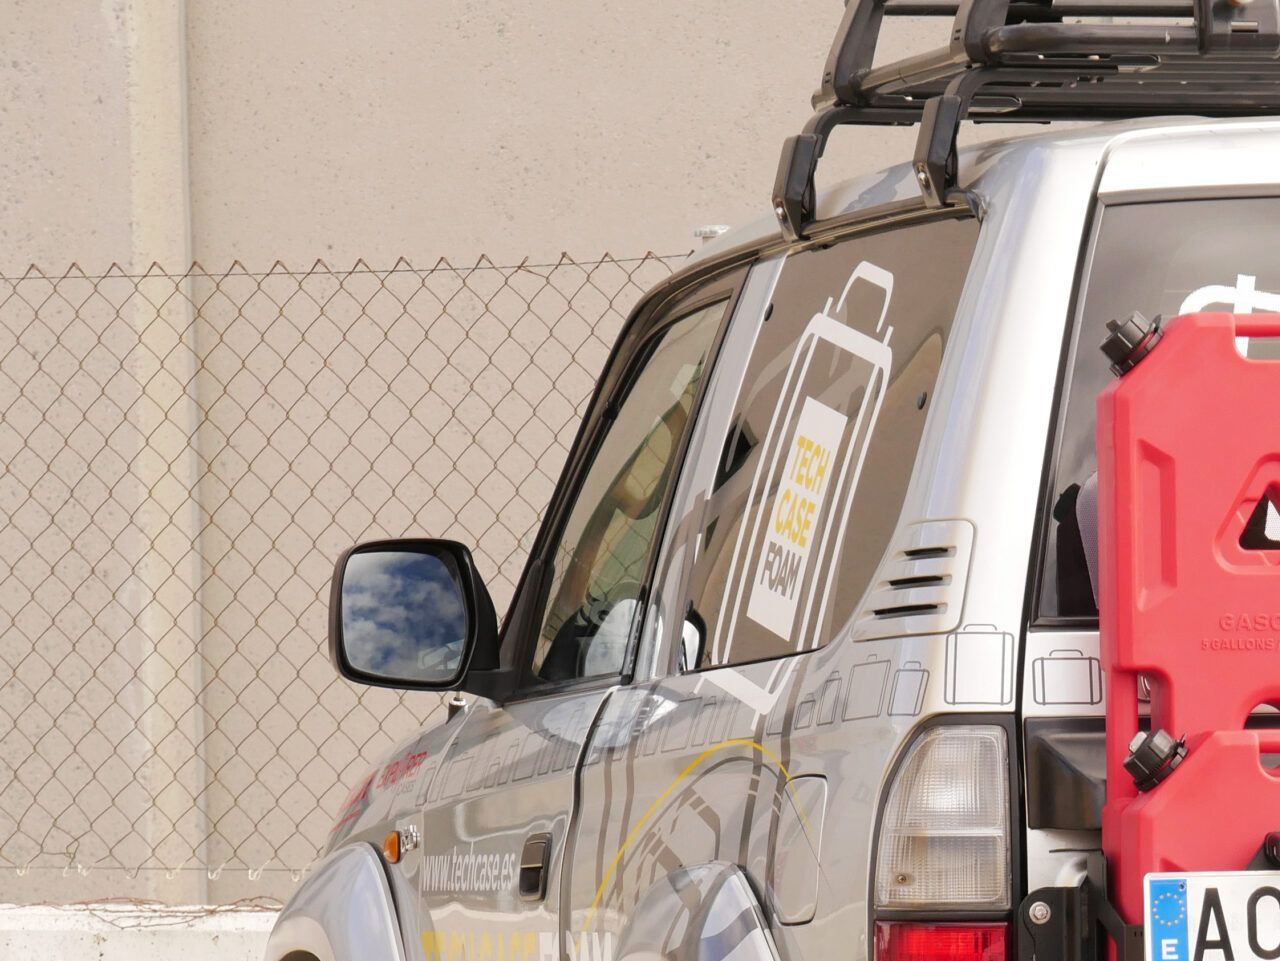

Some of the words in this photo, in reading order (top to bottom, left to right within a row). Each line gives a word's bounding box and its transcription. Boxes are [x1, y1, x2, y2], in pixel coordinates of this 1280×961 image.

[788, 434, 831, 495] TECH
[774, 487, 816, 548] CASE
[760, 541, 802, 601] FOAM
[1211, 638, 1274, 651] GALLONS
[423, 841, 516, 892] www.techcase.es
[1161, 938, 1179, 960] E
